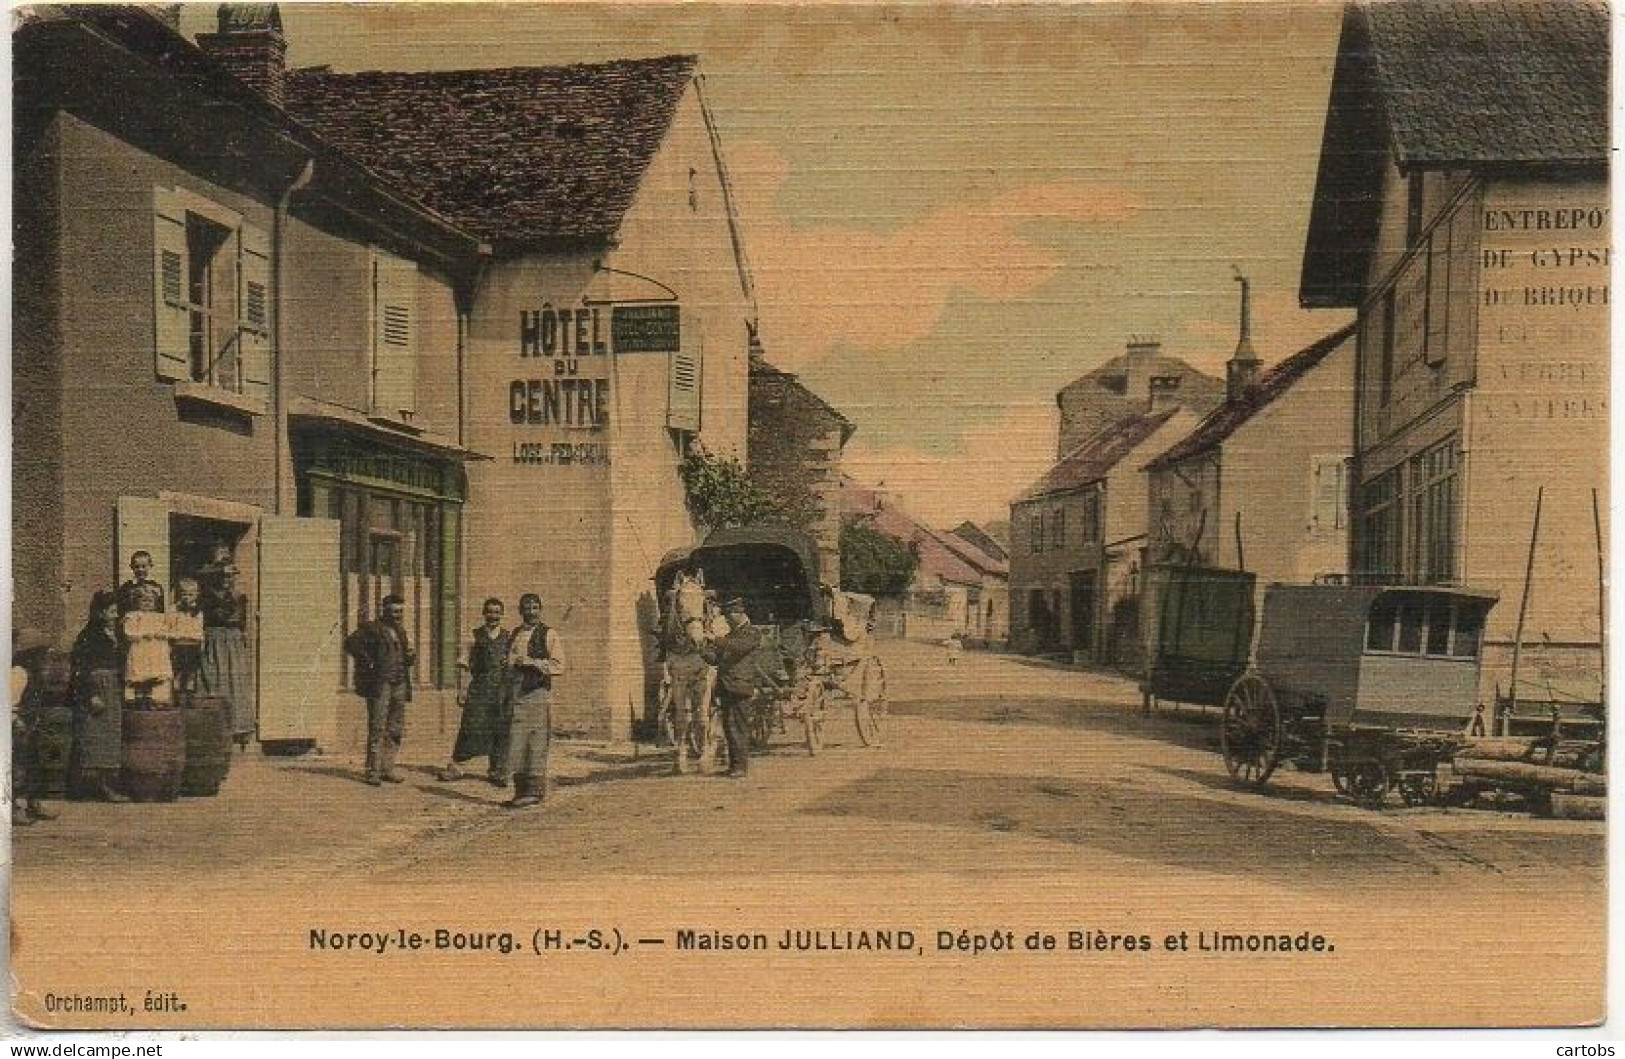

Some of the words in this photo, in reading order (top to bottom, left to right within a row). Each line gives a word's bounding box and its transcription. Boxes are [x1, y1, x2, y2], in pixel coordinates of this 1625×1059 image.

[1483, 249, 1513, 269] DE
[520, 302, 606, 358] HÔTEL
[554, 358, 579, 376] DU
[509, 378, 610, 426] CENTRE
